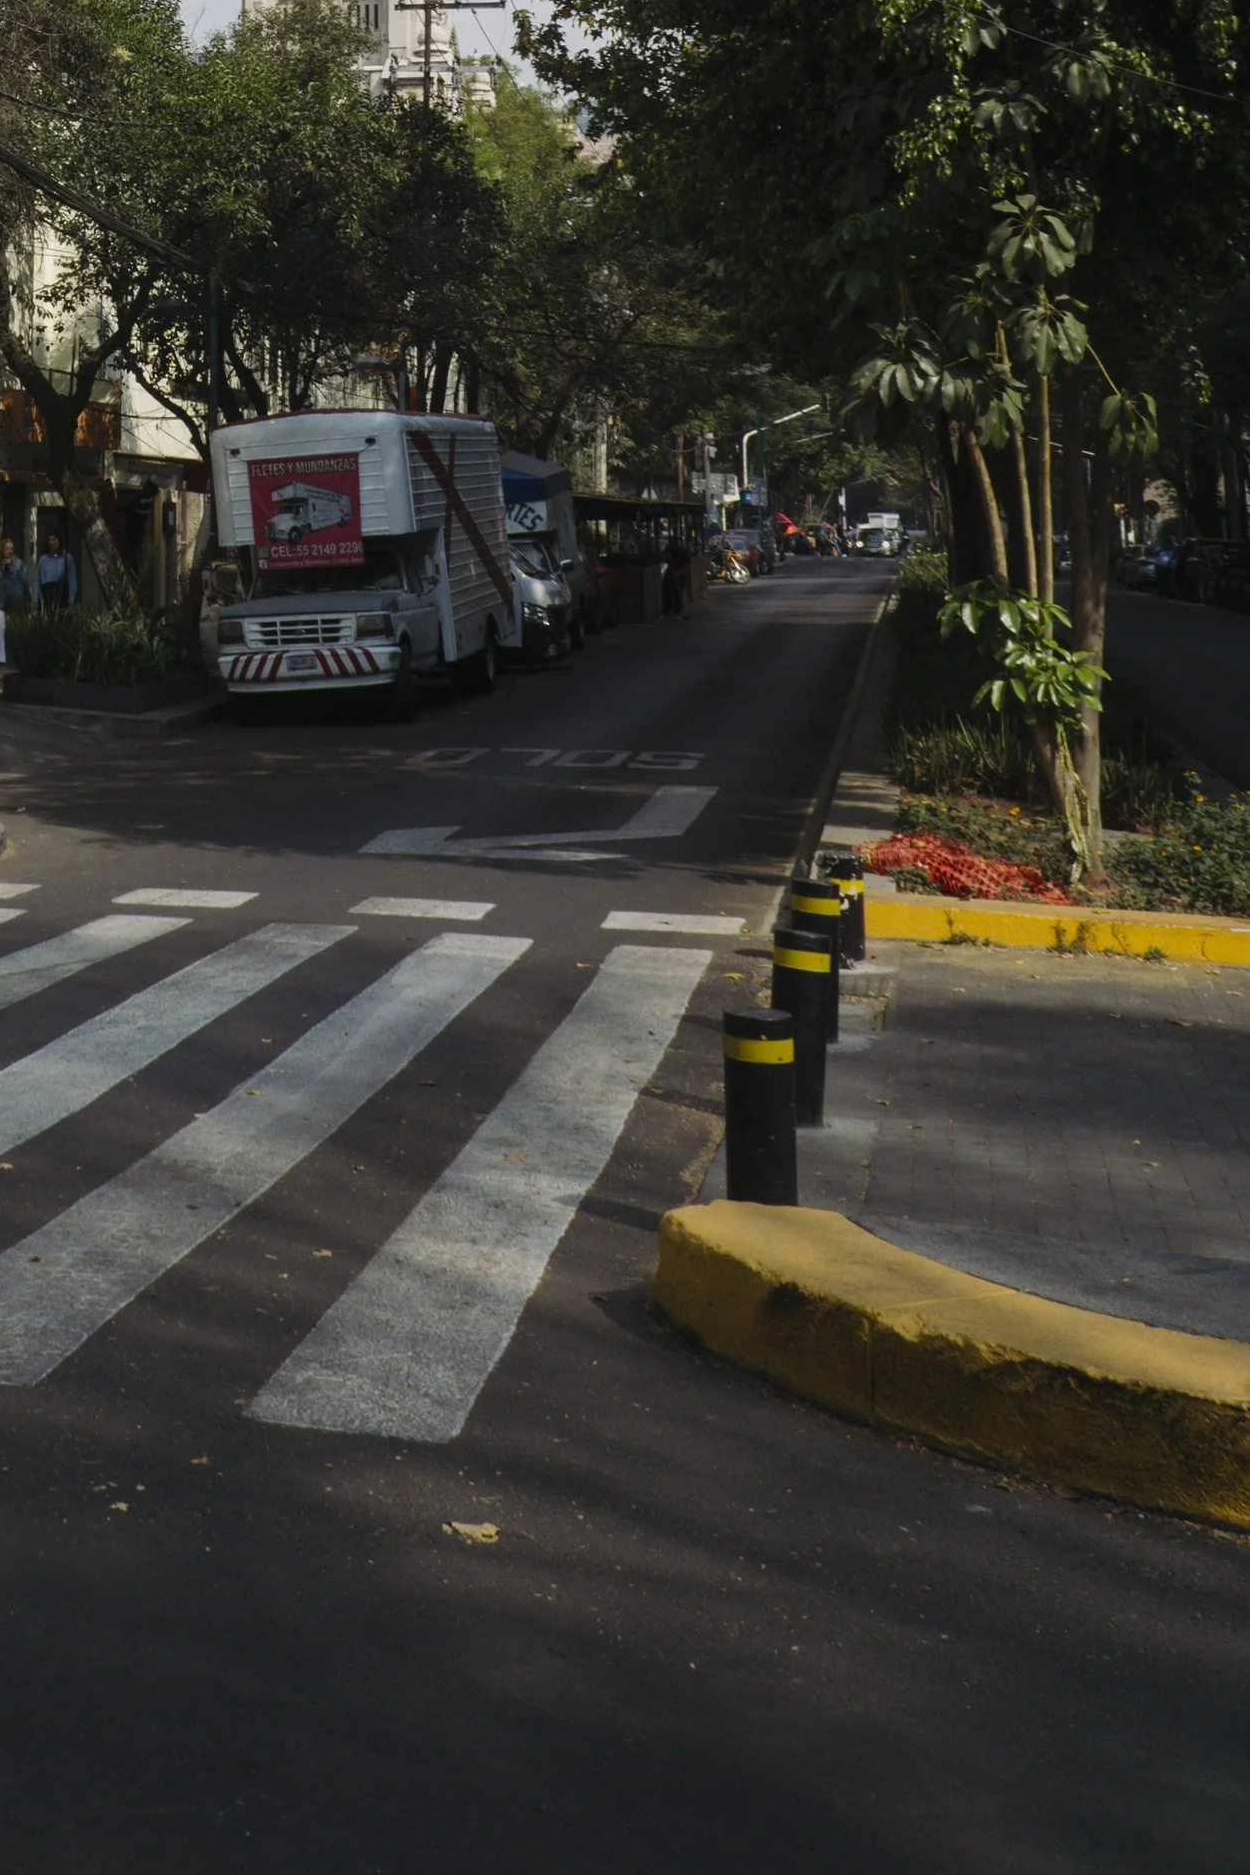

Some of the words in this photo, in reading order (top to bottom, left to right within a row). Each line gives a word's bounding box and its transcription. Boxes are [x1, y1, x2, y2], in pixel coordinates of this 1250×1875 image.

[251, 462, 286, 478] FLETES
[286, 461, 293, 474] Y
[505, 502, 544, 531] RTES
[311, 543, 337, 556] 2149
[406, 746, 707, 771] SOLO
